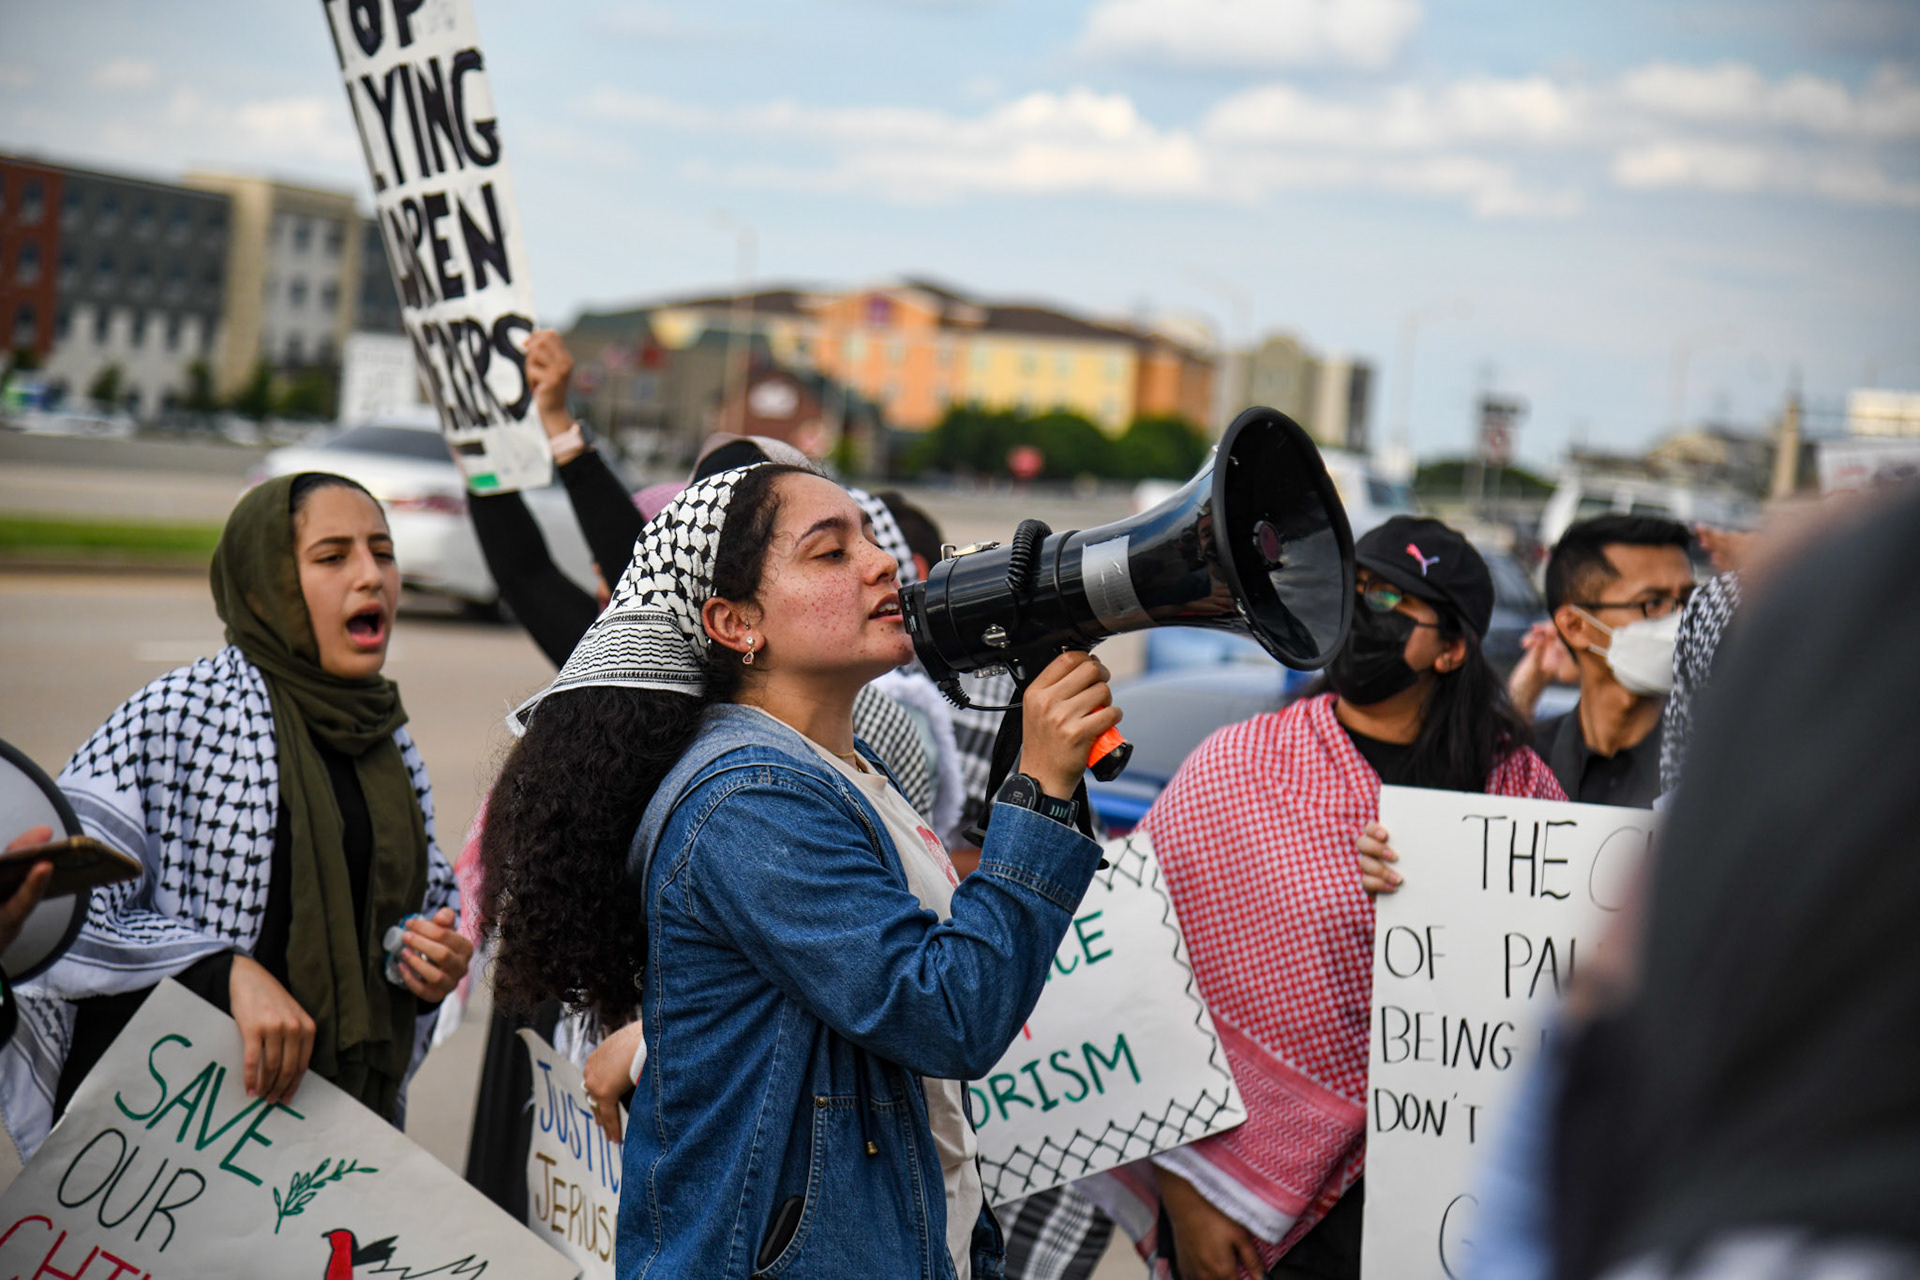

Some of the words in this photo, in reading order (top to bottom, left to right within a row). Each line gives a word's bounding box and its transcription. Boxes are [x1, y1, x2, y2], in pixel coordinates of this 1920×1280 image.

[324, 0, 424, 57] OP
[346, 47, 501, 192] YING
[1463, 814, 1577, 900] THE
[1385, 925, 1446, 980] OF
[1381, 1005, 1519, 1071] BEING
[115, 1033, 305, 1187] SAVE
[1374, 1087, 1483, 1144] DON'T
[57, 1128, 206, 1252] OUR
[535, 1151, 617, 1266] JERUS
